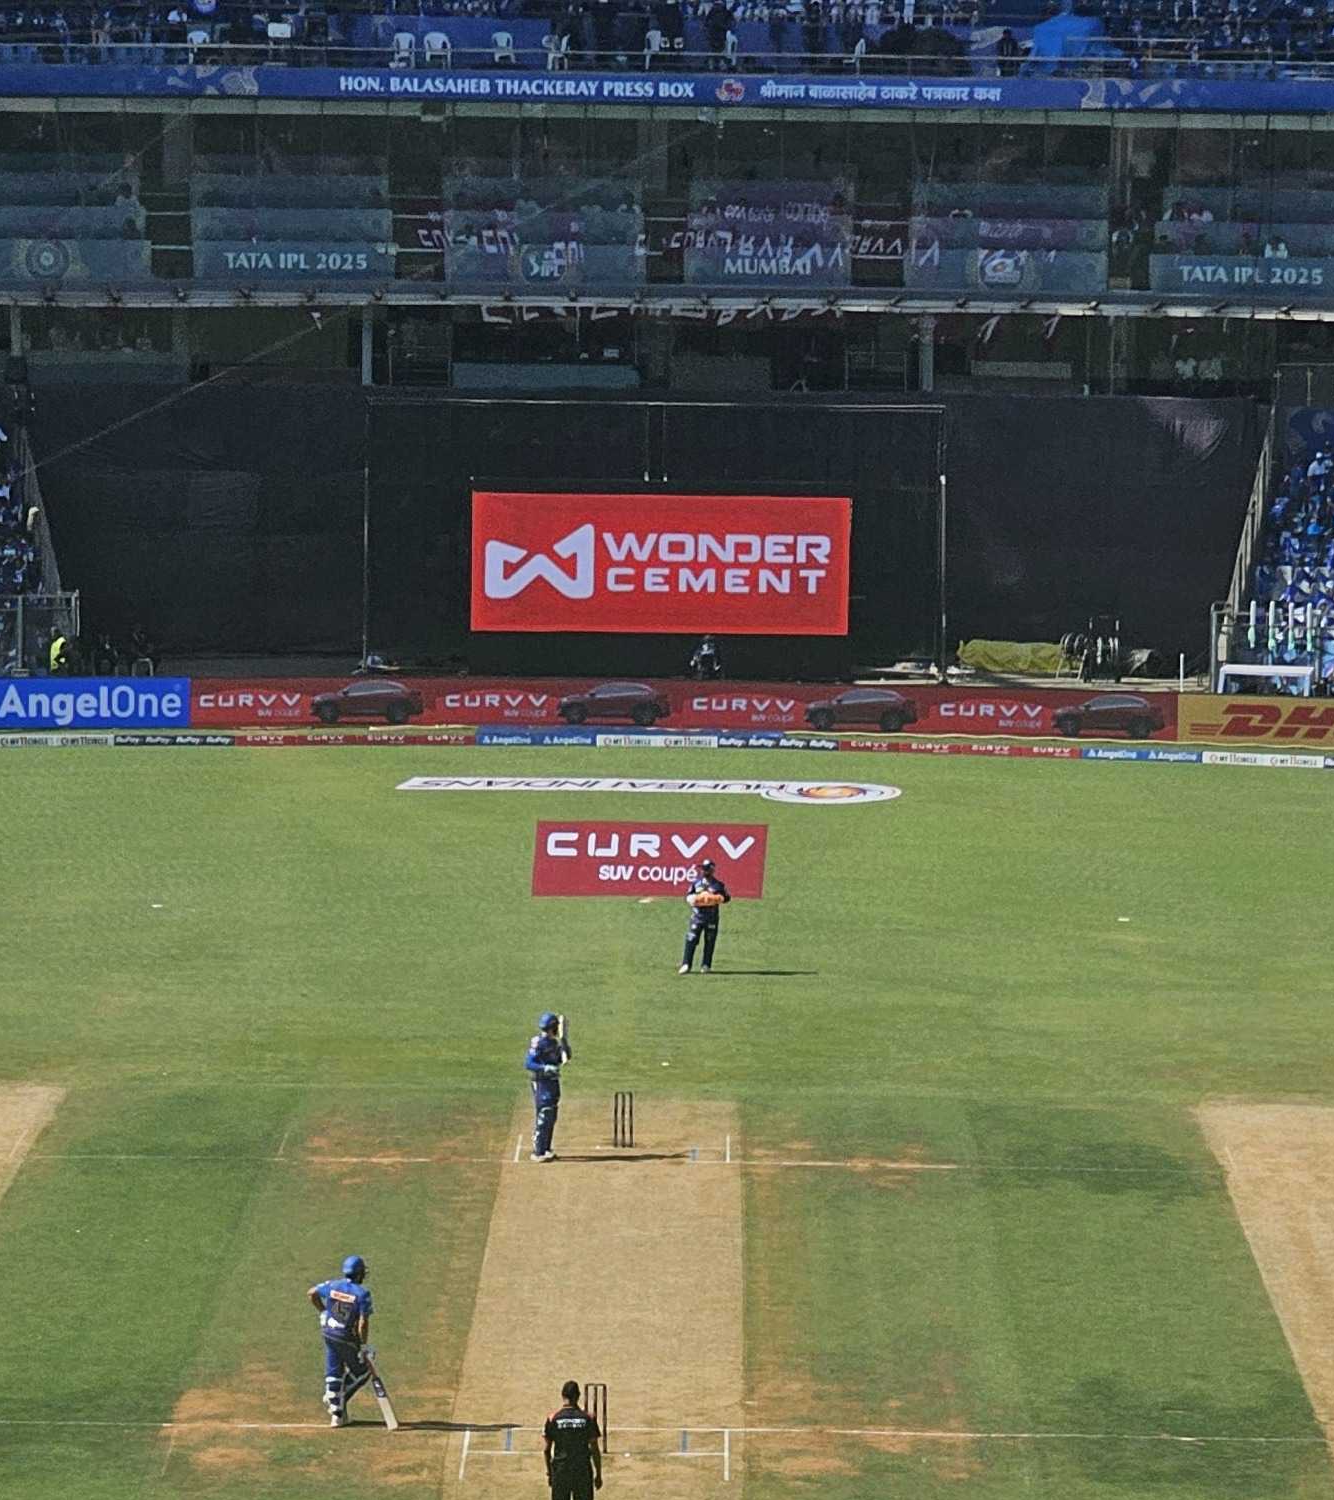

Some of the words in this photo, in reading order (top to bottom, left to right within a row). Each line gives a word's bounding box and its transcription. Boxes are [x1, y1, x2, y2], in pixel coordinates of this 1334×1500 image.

[340, 76, 385, 92] HON.
[390, 77, 490, 94] BALASAHEB
[495, 79, 599, 96] THACKERAY
[603, 80, 653, 97] PRESS
[659, 81, 695, 98] BOX
[224, 252, 273, 269] TATA
[279, 253, 311, 270] IPL
[315, 253, 368, 270] 2025
[724, 258, 812, 276] MUMBAI
[1179, 265, 1229, 283] TATA
[1271, 267, 1323, 285] 2025
[603, 532, 832, 565] WONDER
[606, 568, 827, 594] CEMENT
[199, 692, 301, 707] CURVV
[445, 693, 548, 707] CURVV
[692, 697, 796, 711] CURVV
[939, 702, 1043, 717] CURVV
[546, 832, 756, 860] CURVV
[599, 864, 634, 881] SUV
[638, 864, 698, 885] coupé
